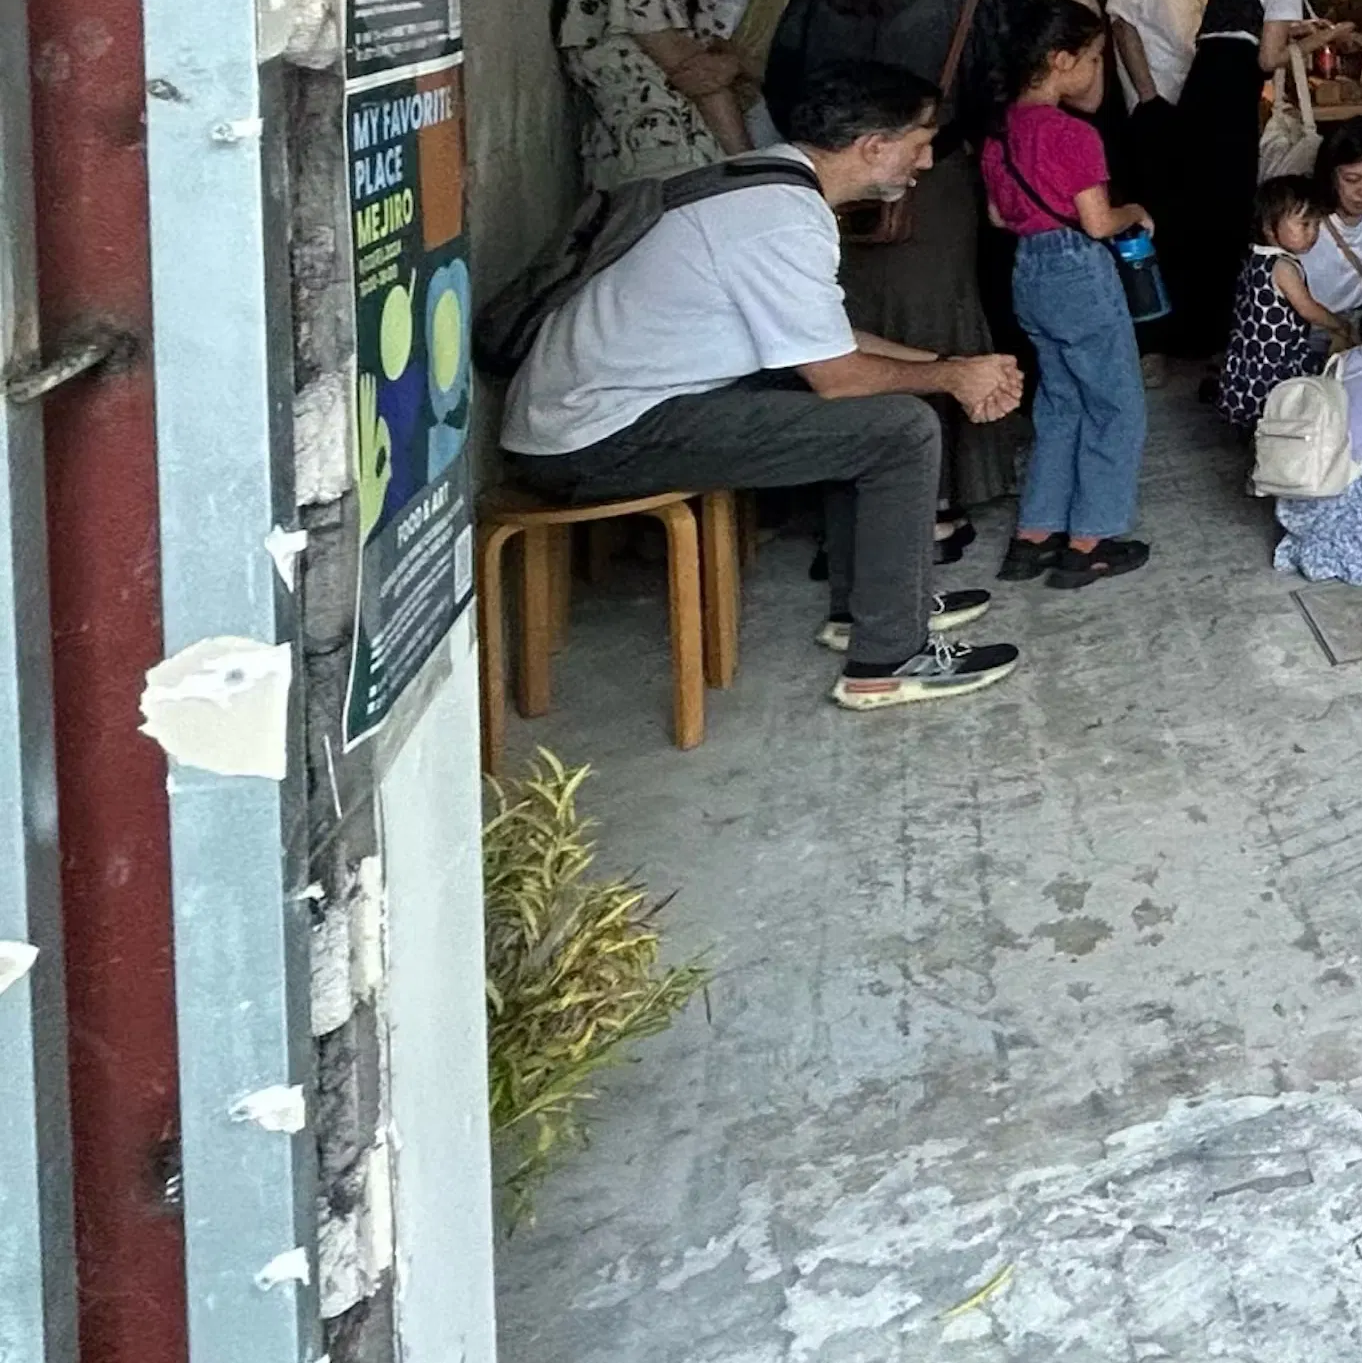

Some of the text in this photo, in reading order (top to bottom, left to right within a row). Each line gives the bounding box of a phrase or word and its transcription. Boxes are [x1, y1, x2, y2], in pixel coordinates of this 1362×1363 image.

[353, 85, 454, 152] MY FAVORITE
[354, 144, 404, 200] PLACE
[355, 187, 414, 248] MEJIRO
